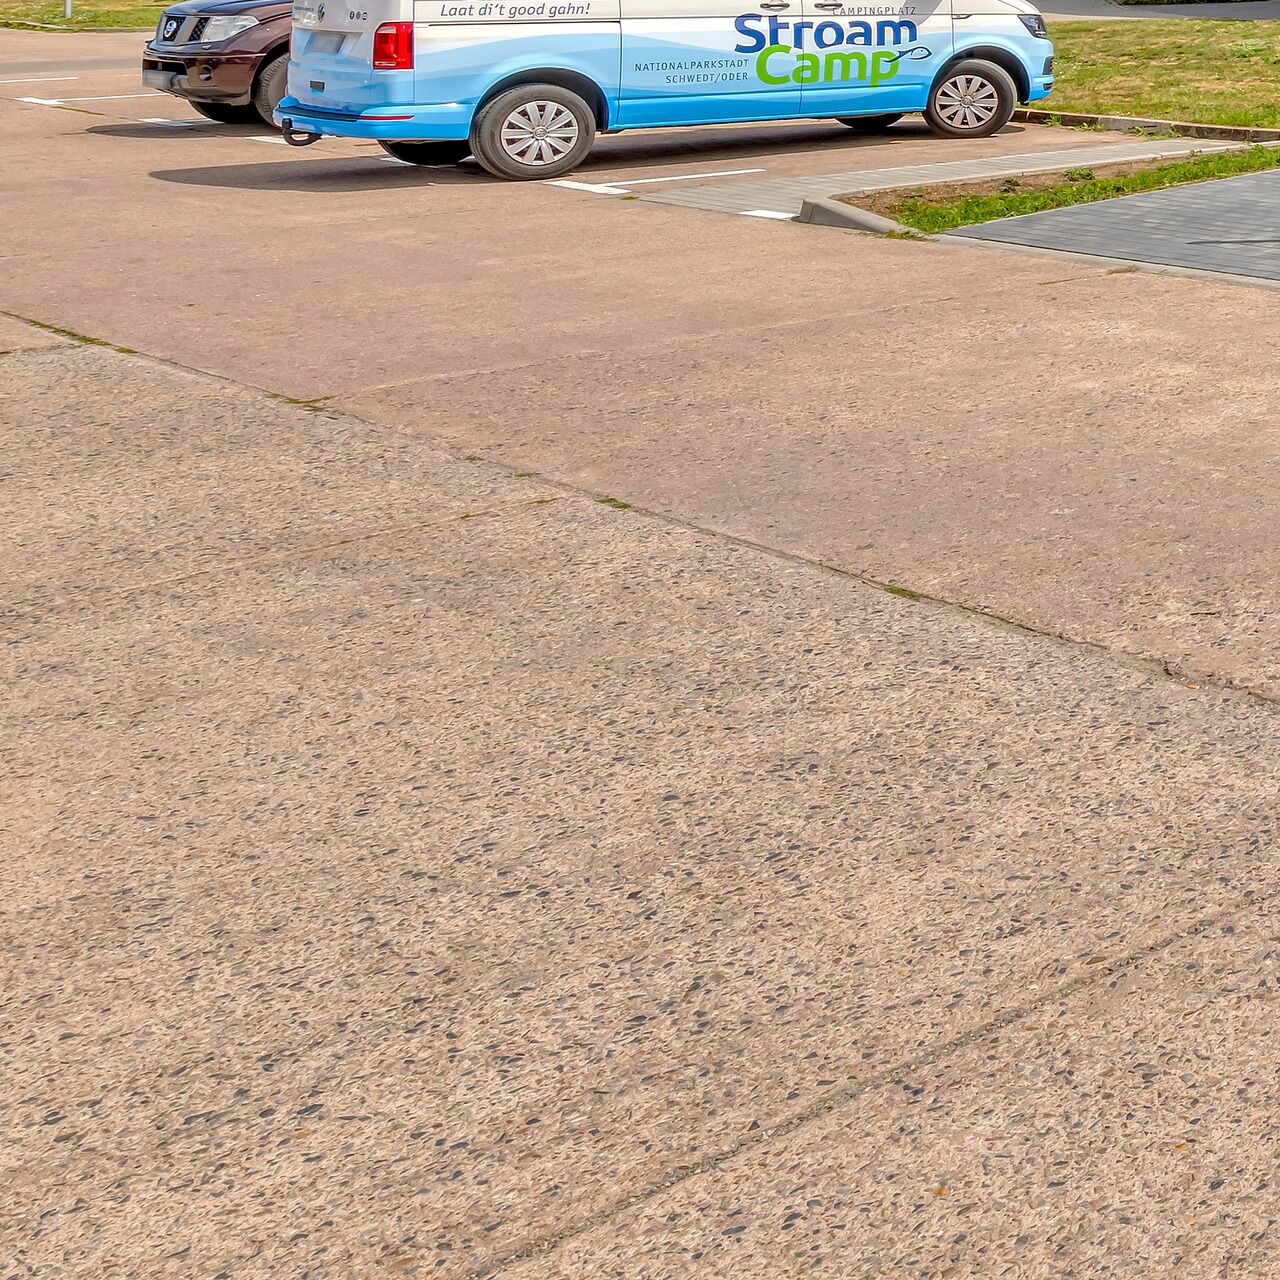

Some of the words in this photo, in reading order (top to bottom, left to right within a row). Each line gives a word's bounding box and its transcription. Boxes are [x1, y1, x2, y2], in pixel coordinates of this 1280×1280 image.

[440, 4, 474, 17] Laat
[508, 3, 546, 19] good
[549, 2, 591, 18] gahn!
[832, 6, 916, 16] CAMPINGPLATZ
[734, 13, 918, 54] Stroam
[635, 58, 749, 72] NATIONALPARKSTADT
[756, 44, 899, 88] Camp
[665, 72, 749, 84] SCHWEDT/ODER
